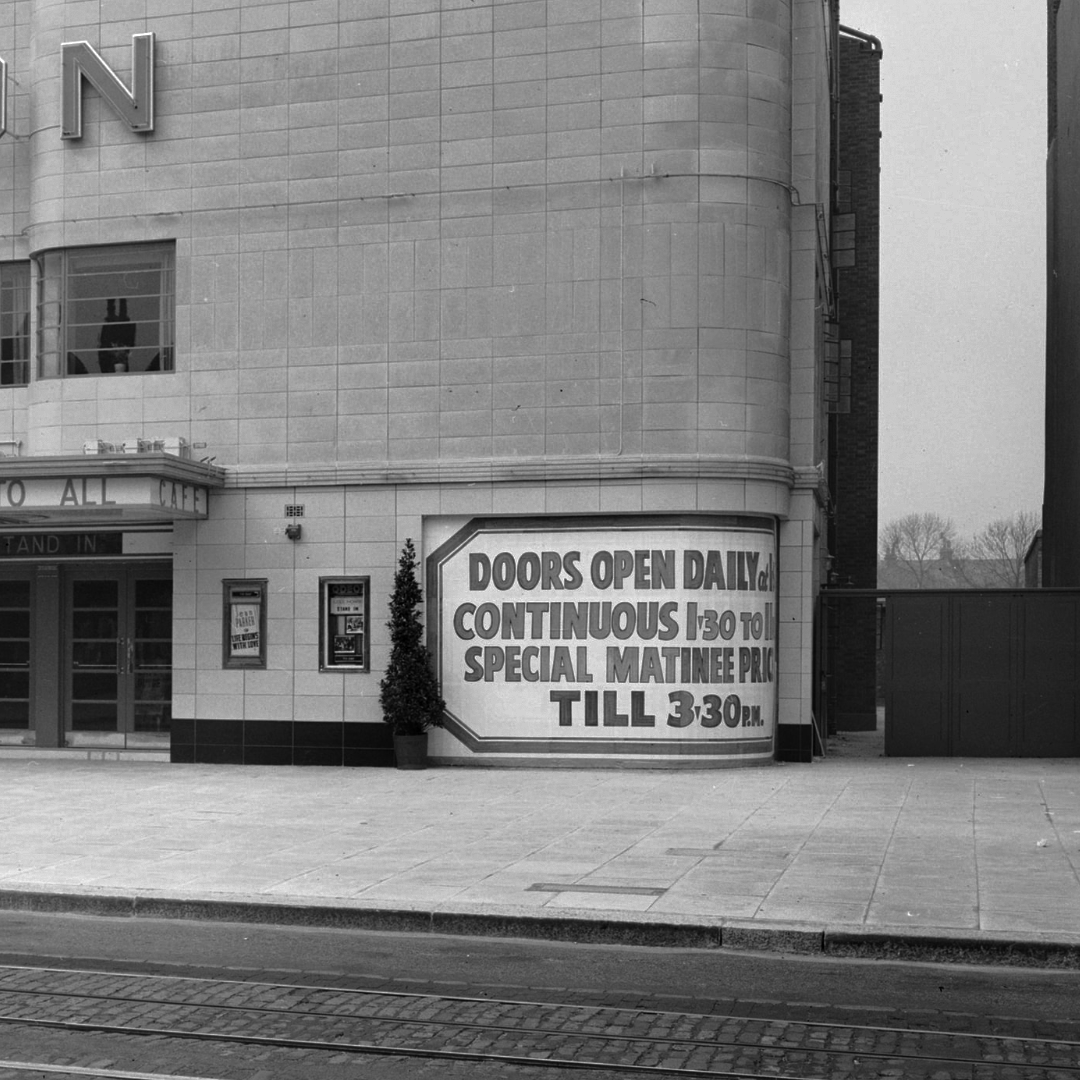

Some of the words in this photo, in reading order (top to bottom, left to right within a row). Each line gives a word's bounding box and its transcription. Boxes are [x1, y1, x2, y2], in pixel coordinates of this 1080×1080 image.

[59, 477, 116, 507] ALL
[159, 478, 200, 514] CAFE
[77, 535, 97, 552] IN
[468, 550, 583, 591] DOORS
[590, 549, 676, 590] OPEN
[683, 549, 760, 591] DAILY
[453, 601, 679, 641] CONTINUOUS
[740, 611, 763, 640] TO
[464, 646, 593, 683] SPECIAL
[605, 646, 735, 684] MATINEE
[549, 690, 656, 728] TILL
